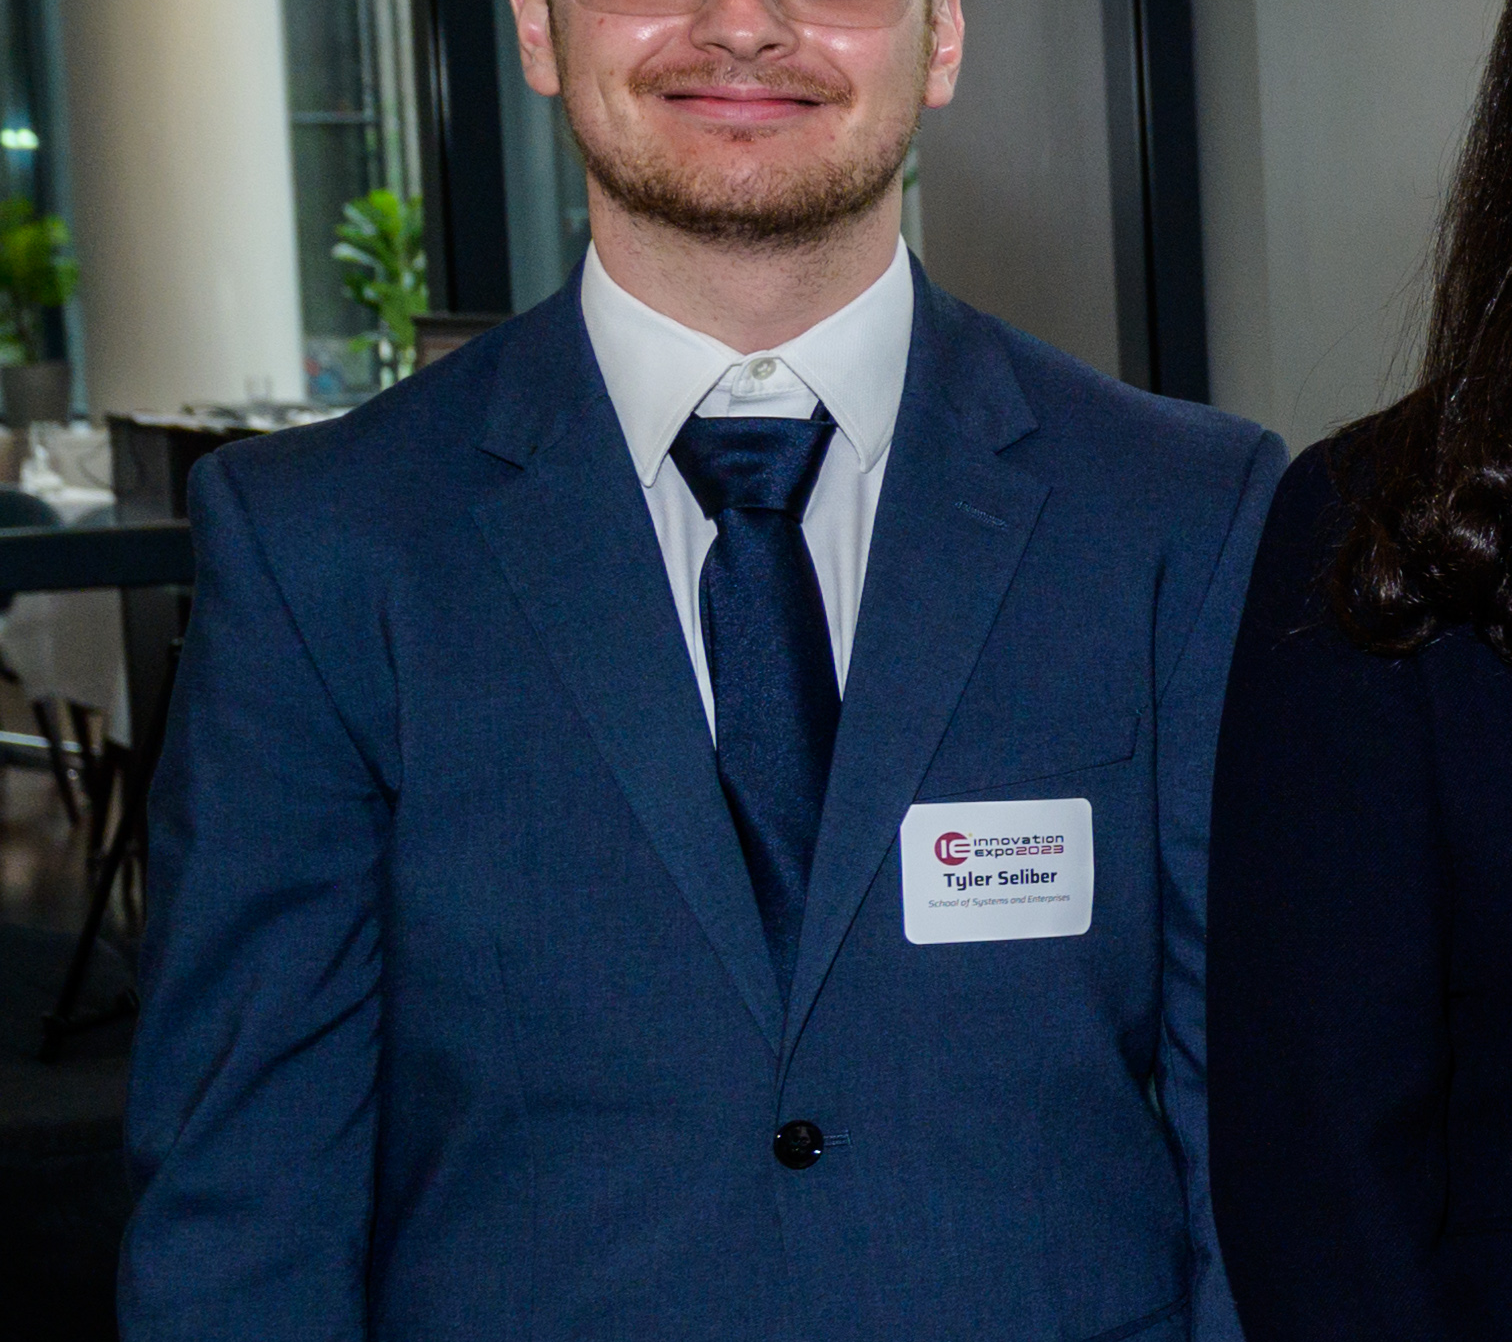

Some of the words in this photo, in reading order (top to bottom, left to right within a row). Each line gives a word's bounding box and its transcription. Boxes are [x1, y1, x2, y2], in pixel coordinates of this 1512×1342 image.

[943, 871, 993, 891] Tyler
[998, 869, 1058, 885] Seliber
[928, 898, 959, 908] School
[960, 898, 971, 908] of
[972, 896, 1009, 907] Systems
[1027, 893, 1071, 904] Enterprises
